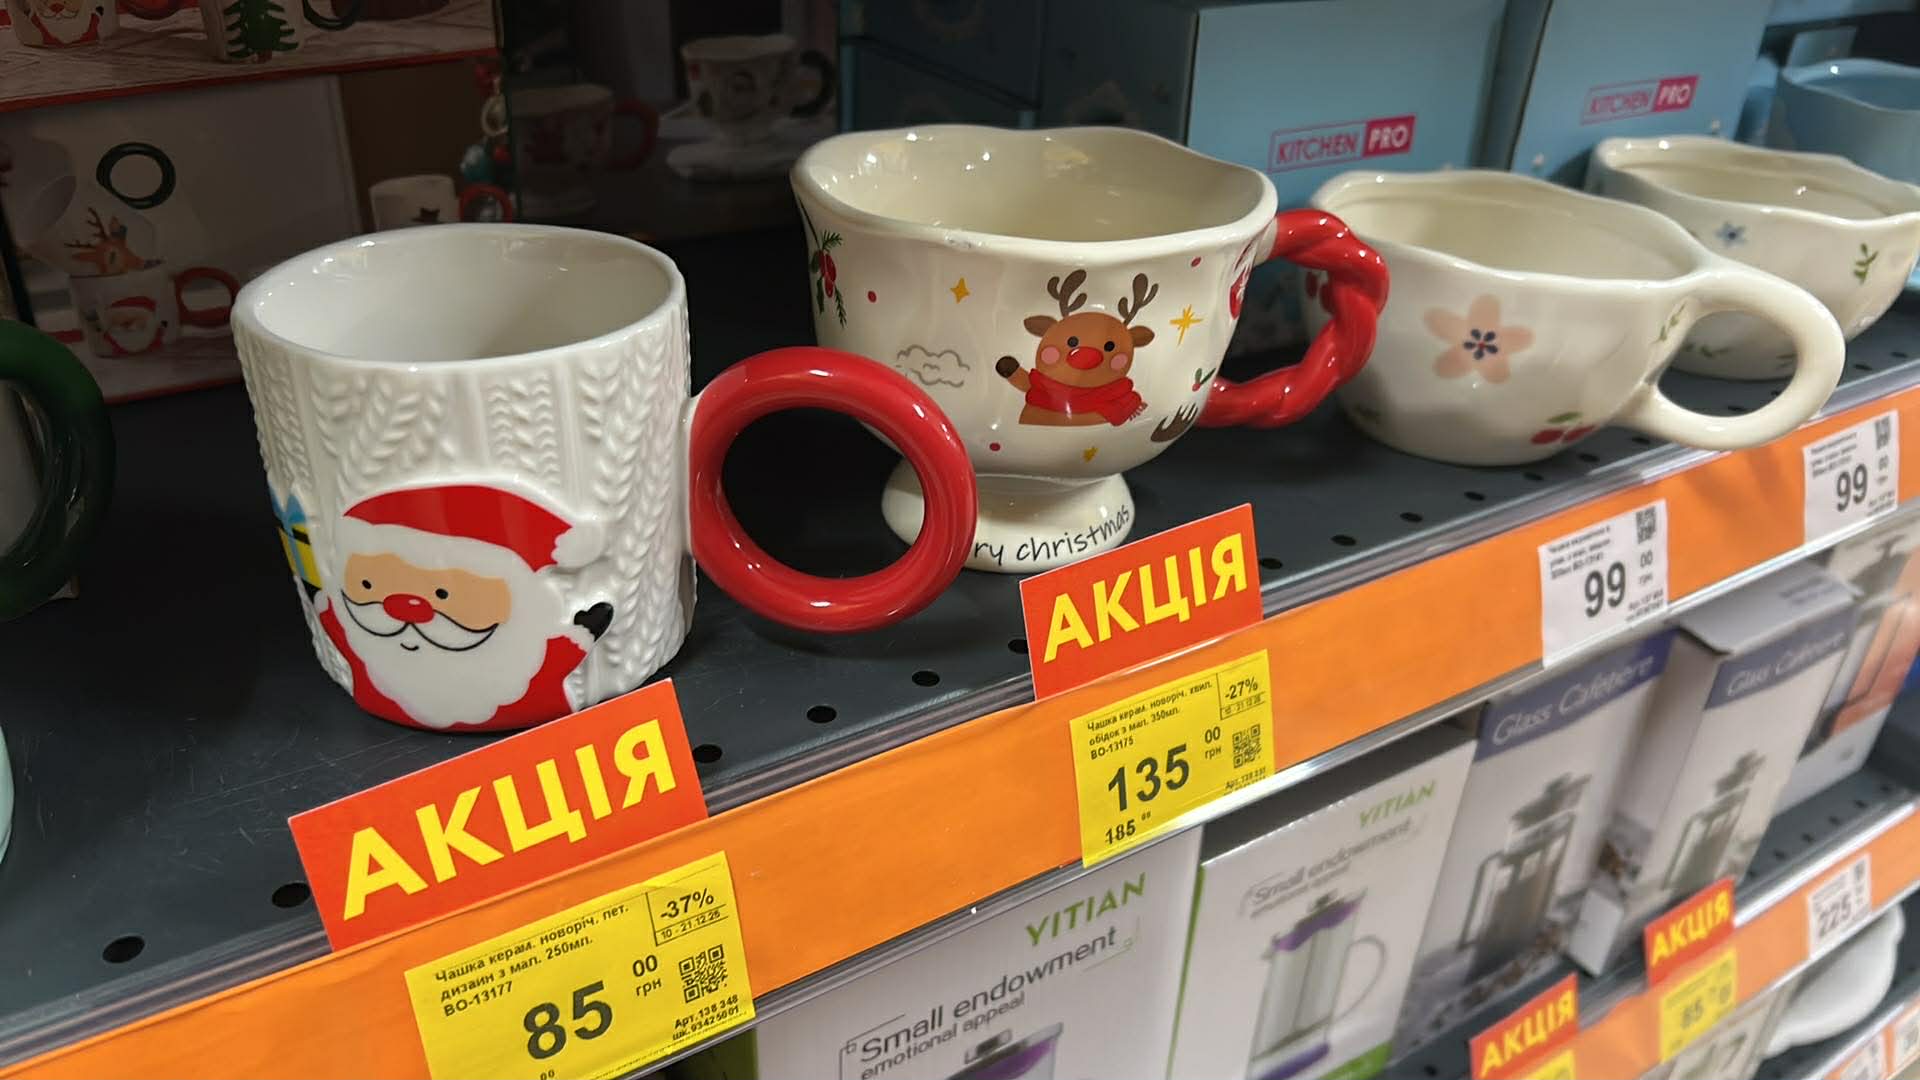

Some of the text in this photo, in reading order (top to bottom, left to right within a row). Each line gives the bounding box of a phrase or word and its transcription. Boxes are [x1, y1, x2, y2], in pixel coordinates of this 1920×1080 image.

[1589, 79, 1690, 115] KITCHEN PRO
[1276, 120, 1409, 163] KITCHEN PRO
[1837, 464, 1868, 512] 99
[1016, 504, 1130, 562] christmas
[1043, 532, 1248, 664] АКЦІЯ
[1585, 562, 1626, 618] 99
[1225, 676, 1258, 700] -27%
[1088, 716, 1117, 731] Чашка
[1204, 726, 1221, 744] 00
[1492, 704, 1553, 746] Glass
[1205, 746, 1221, 760] грн
[1108, 743, 1190, 812] 135
[343, 719, 676, 921] АКЦІЯ
[1360, 779, 1436, 829] YITIAN
[1105, 819, 1136, 844] 185
[660, 888, 714, 919] -37%
[1025, 872, 1146, 947] YITIAN
[435, 958, 486, 982] Чашка
[489, 941, 536, 966] керам.
[540, 916, 599, 945] новоріч.
[661, 928, 673, 939] 10
[1651, 890, 1730, 968] АКЦІЯ
[499, 968, 506, 978] з
[633, 954, 658, 977] 00
[636, 978, 662, 997] грн
[443, 980, 513, 1016] ВО-13177
[860, 926, 1118, 1063] Small endowment
[523, 980, 613, 1060] 85
[861, 990, 1026, 1080] emotional appeal
[1479, 990, 1574, 1079] АКЦІЯ
